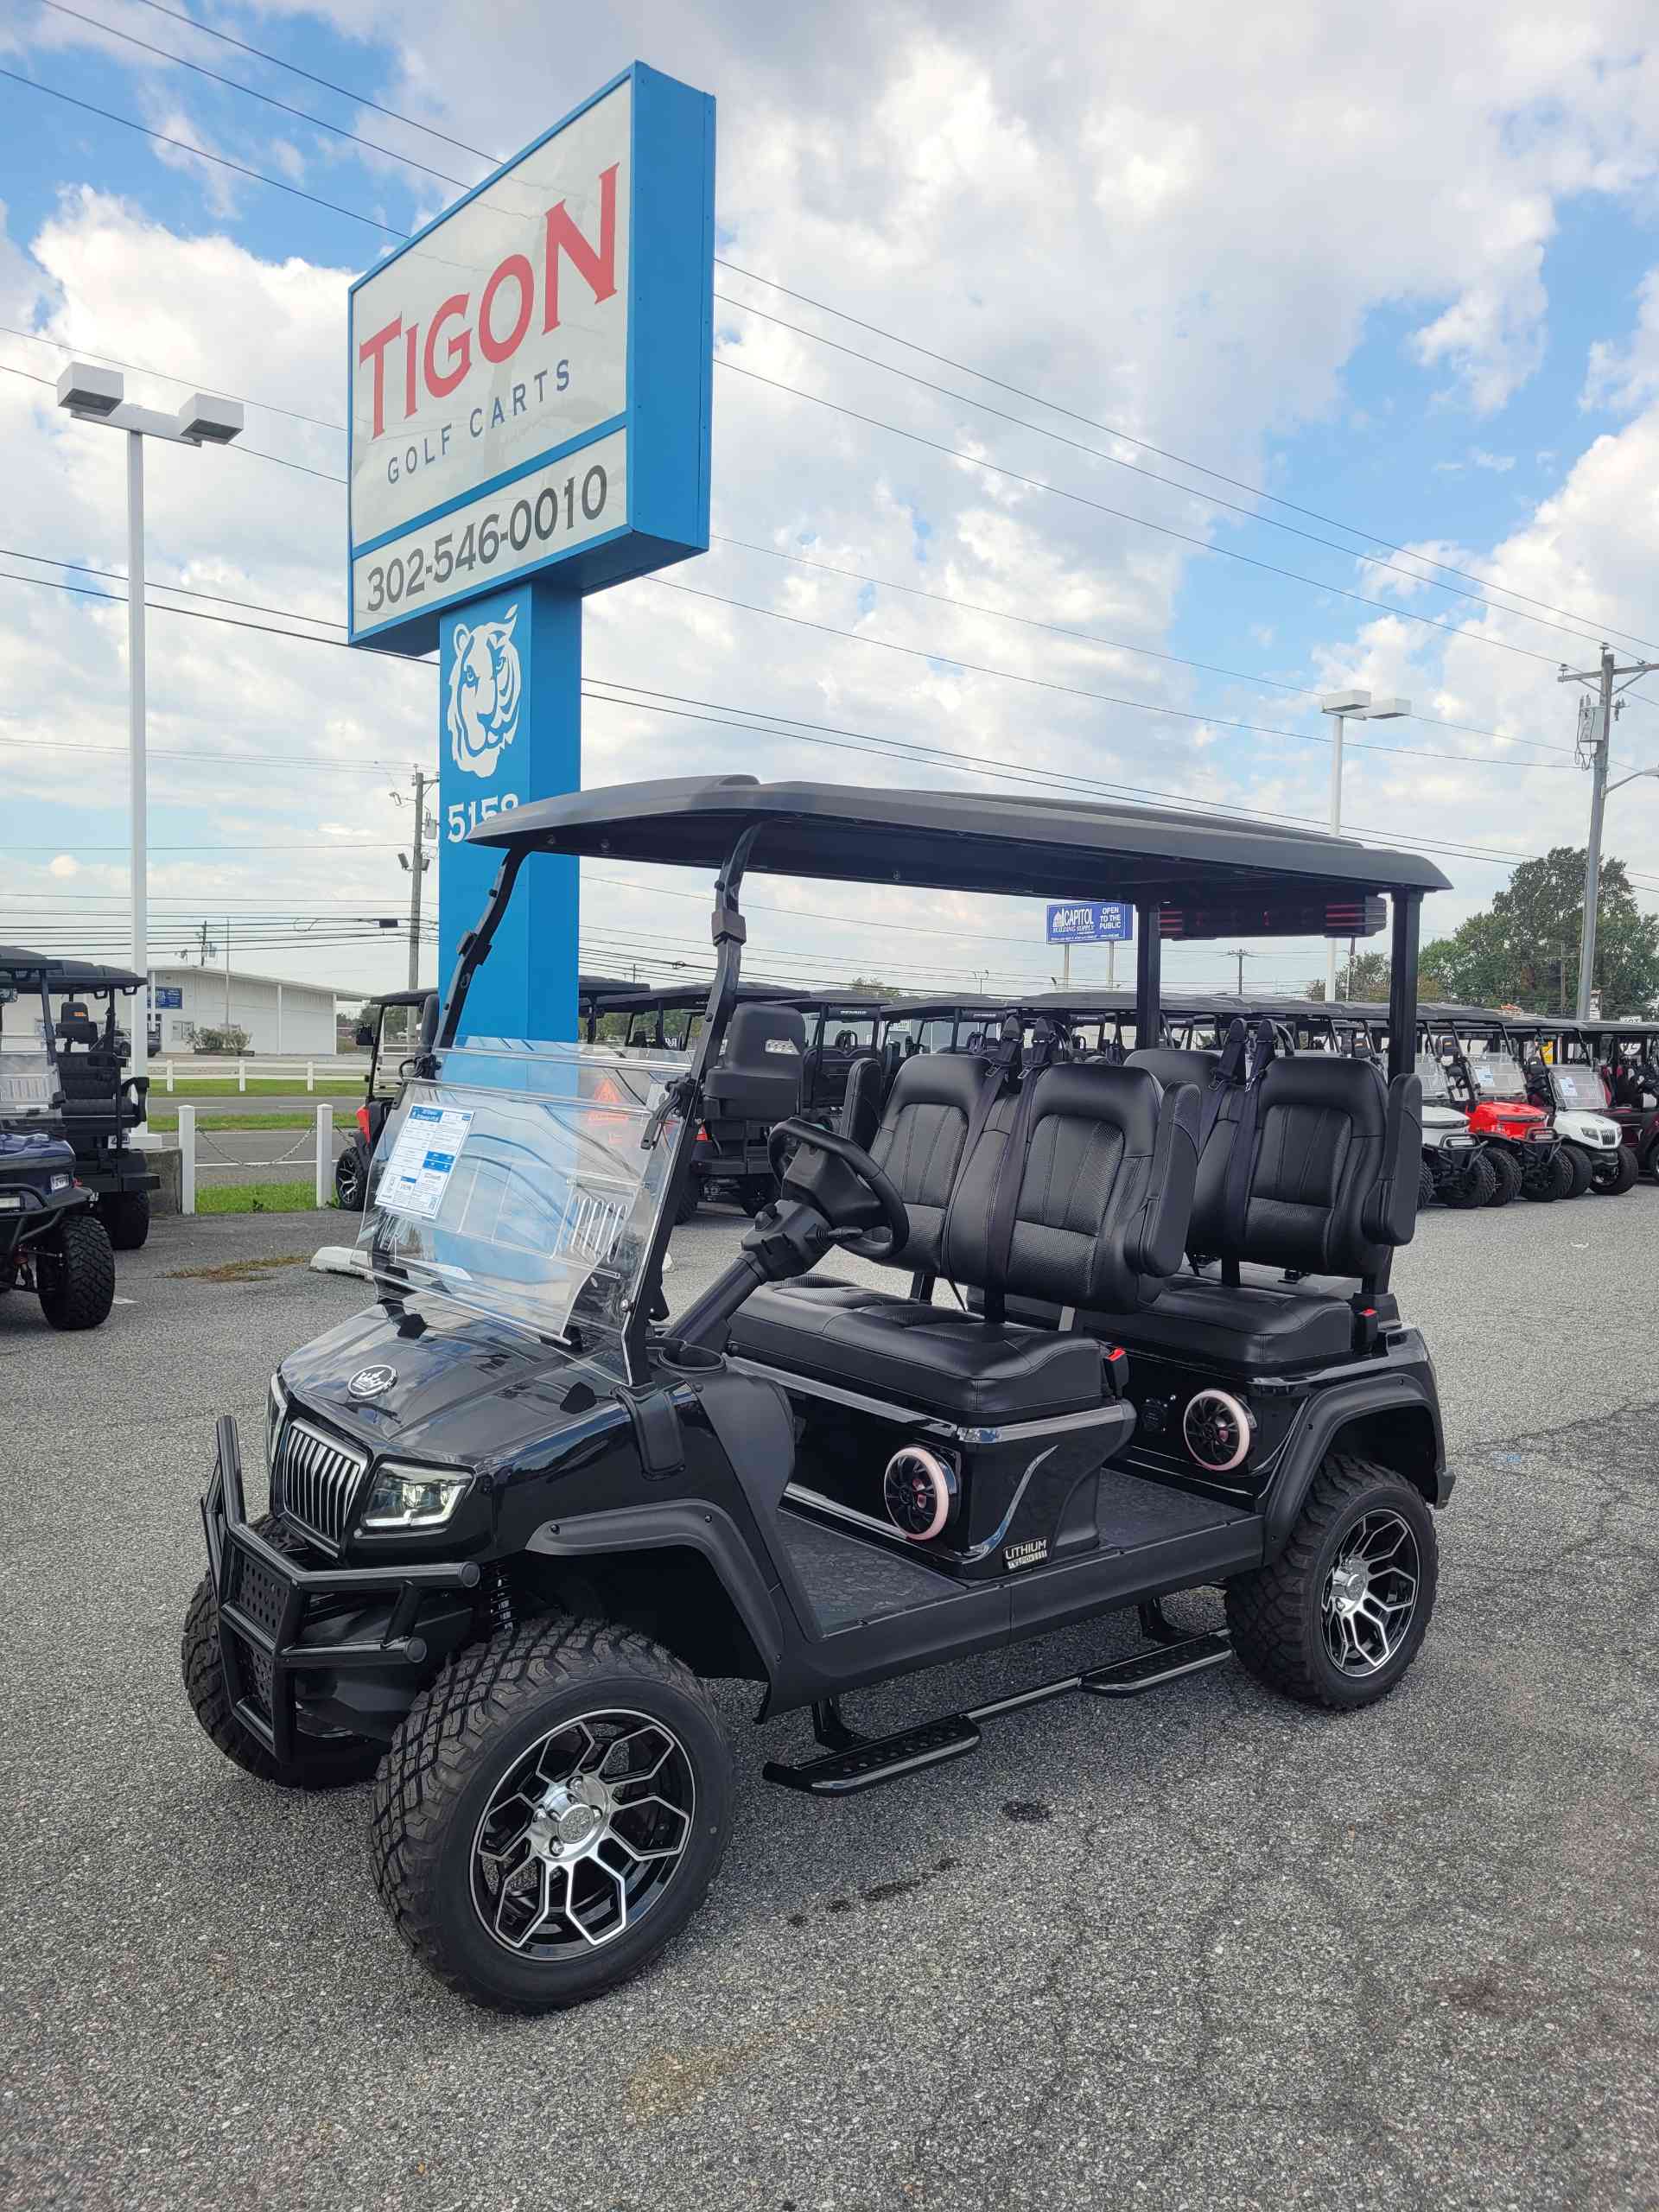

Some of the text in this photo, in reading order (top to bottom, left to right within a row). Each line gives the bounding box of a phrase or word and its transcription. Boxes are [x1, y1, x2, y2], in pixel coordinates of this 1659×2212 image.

[359, 162, 620, 441] TIGON
[386, 358, 570, 485] GOLF CARTS
[365, 464, 607, 613] 302-546-0010
[1064, 908, 1094, 926] CAPITOL
[1099, 921, 1122, 930] PUBLIC
[1005, 1539, 1047, 1560] LITHIUM
